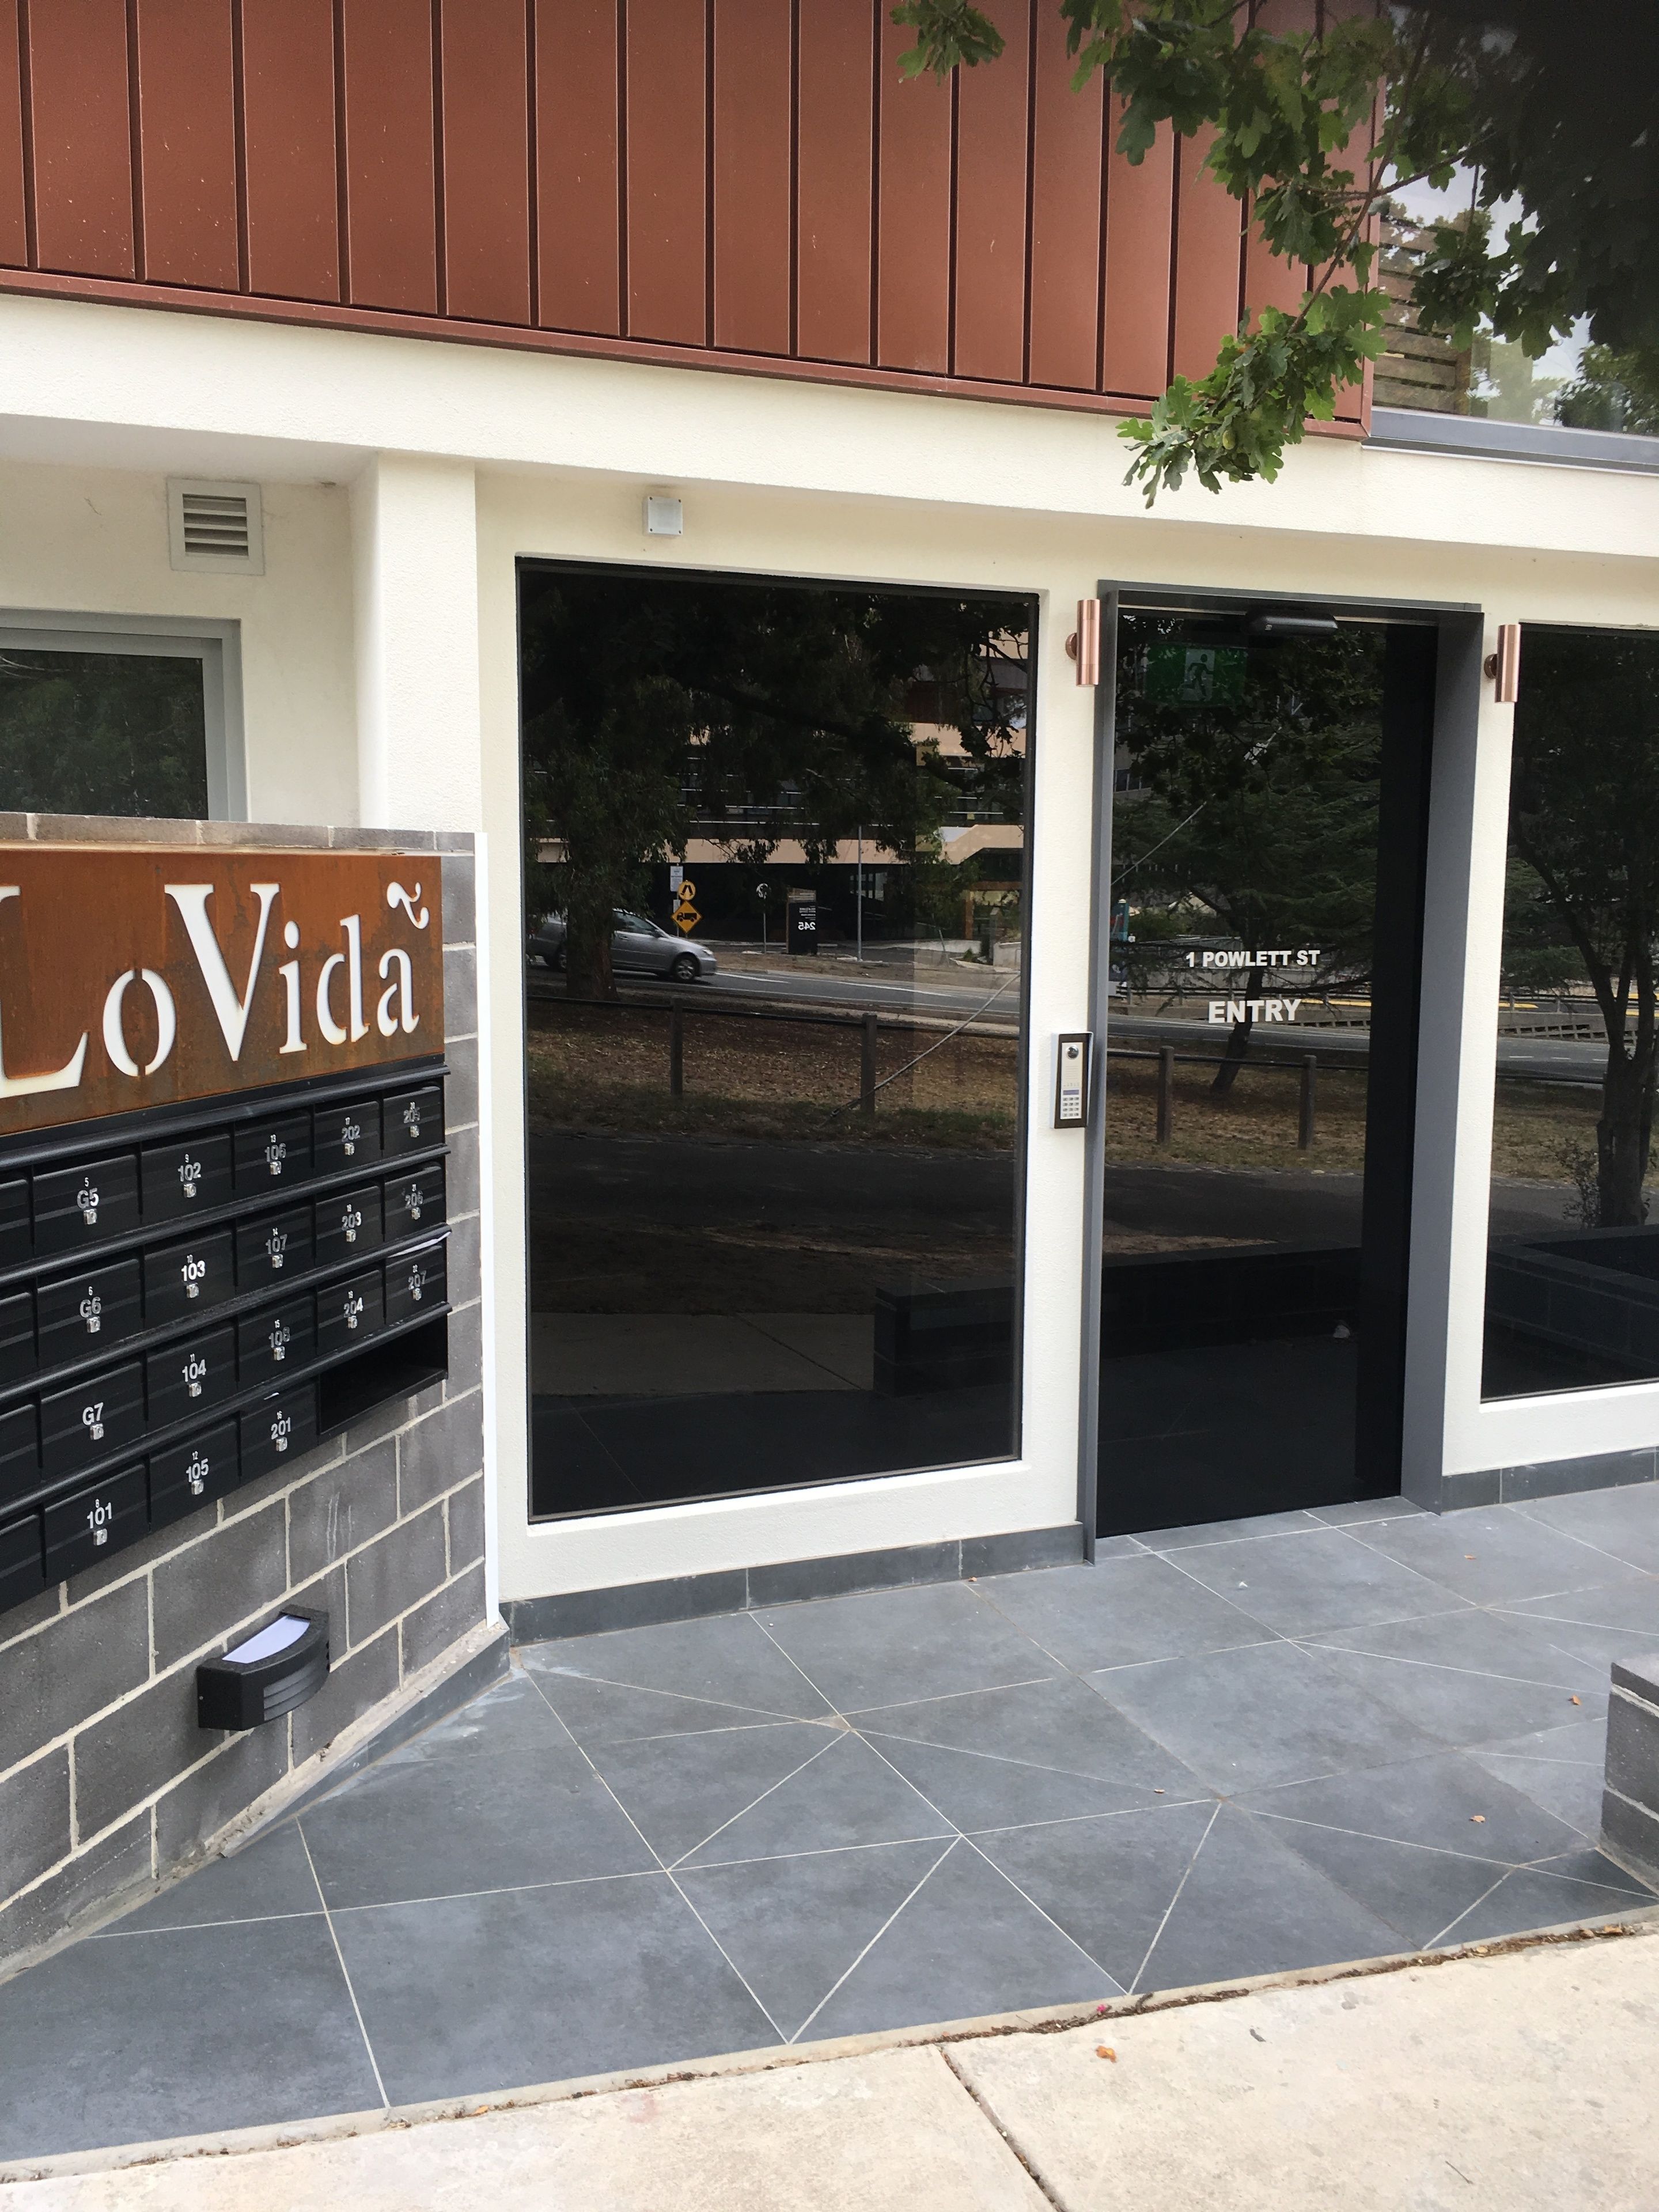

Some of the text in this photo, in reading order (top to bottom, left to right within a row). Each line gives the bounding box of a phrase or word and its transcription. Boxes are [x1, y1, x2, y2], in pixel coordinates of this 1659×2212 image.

[1185, 949, 1321, 968] 1 POWLETT ST
[1208, 998, 1302, 1024] ENTRY
[341, 1125, 361, 1142] 202
[265, 1143, 286, 1162] 106
[178, 1162, 201, 1181] 102
[77, 1187, 100, 1209] G5
[341, 1211, 362, 1231] 203
[266, 1234, 287, 1255] 107
[181, 1260, 206, 1282] 103
[408, 1270, 427, 1291] 207
[79, 1296, 102, 1318] G6
[343, 1297, 364, 1318] 204
[268, 1327, 290, 1349] 108
[182, 1359, 207, 1382] 104
[82, 1402, 104, 1426] G7
[270, 1416, 291, 1440] 201
[186, 1458, 209, 1482] 105
[86, 1502, 112, 1529] 101
